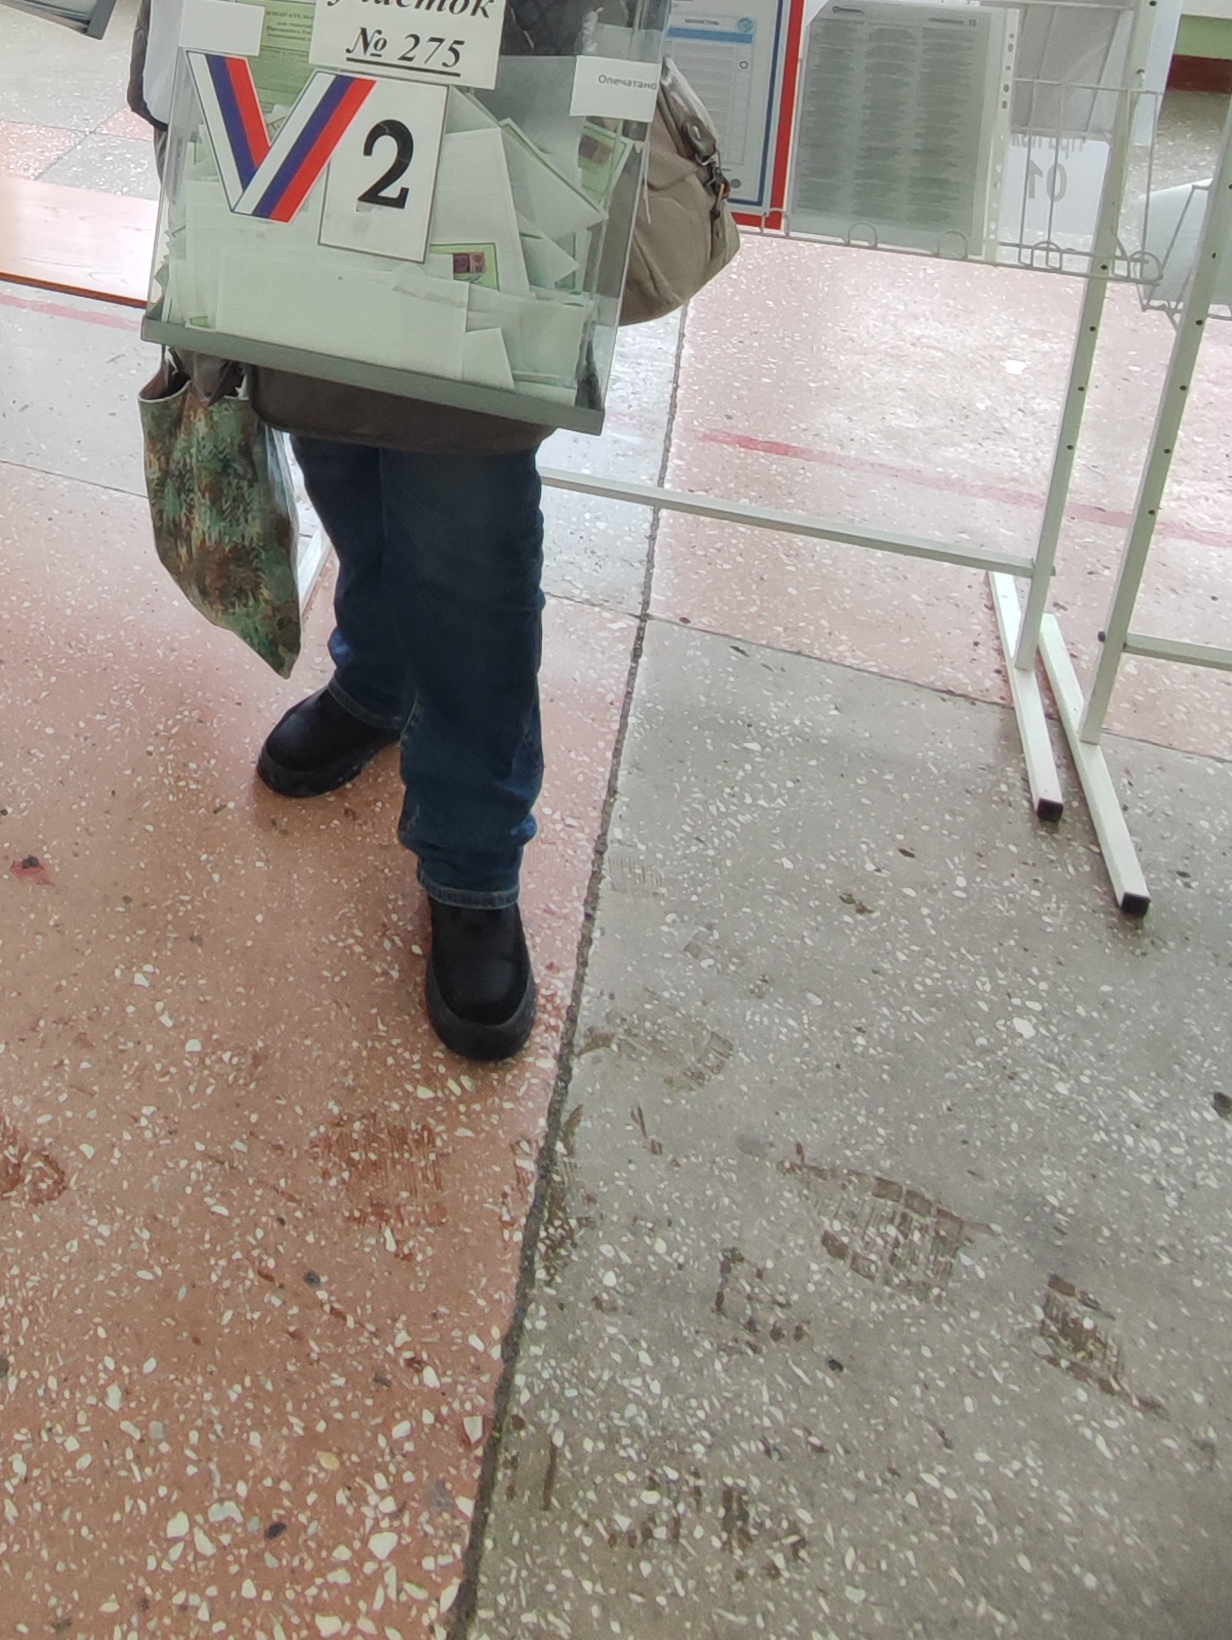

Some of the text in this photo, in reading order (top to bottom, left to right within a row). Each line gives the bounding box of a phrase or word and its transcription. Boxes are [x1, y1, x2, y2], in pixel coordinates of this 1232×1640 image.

[345, 26, 465, 68] № 275
[356, 118, 415, 210] 2
